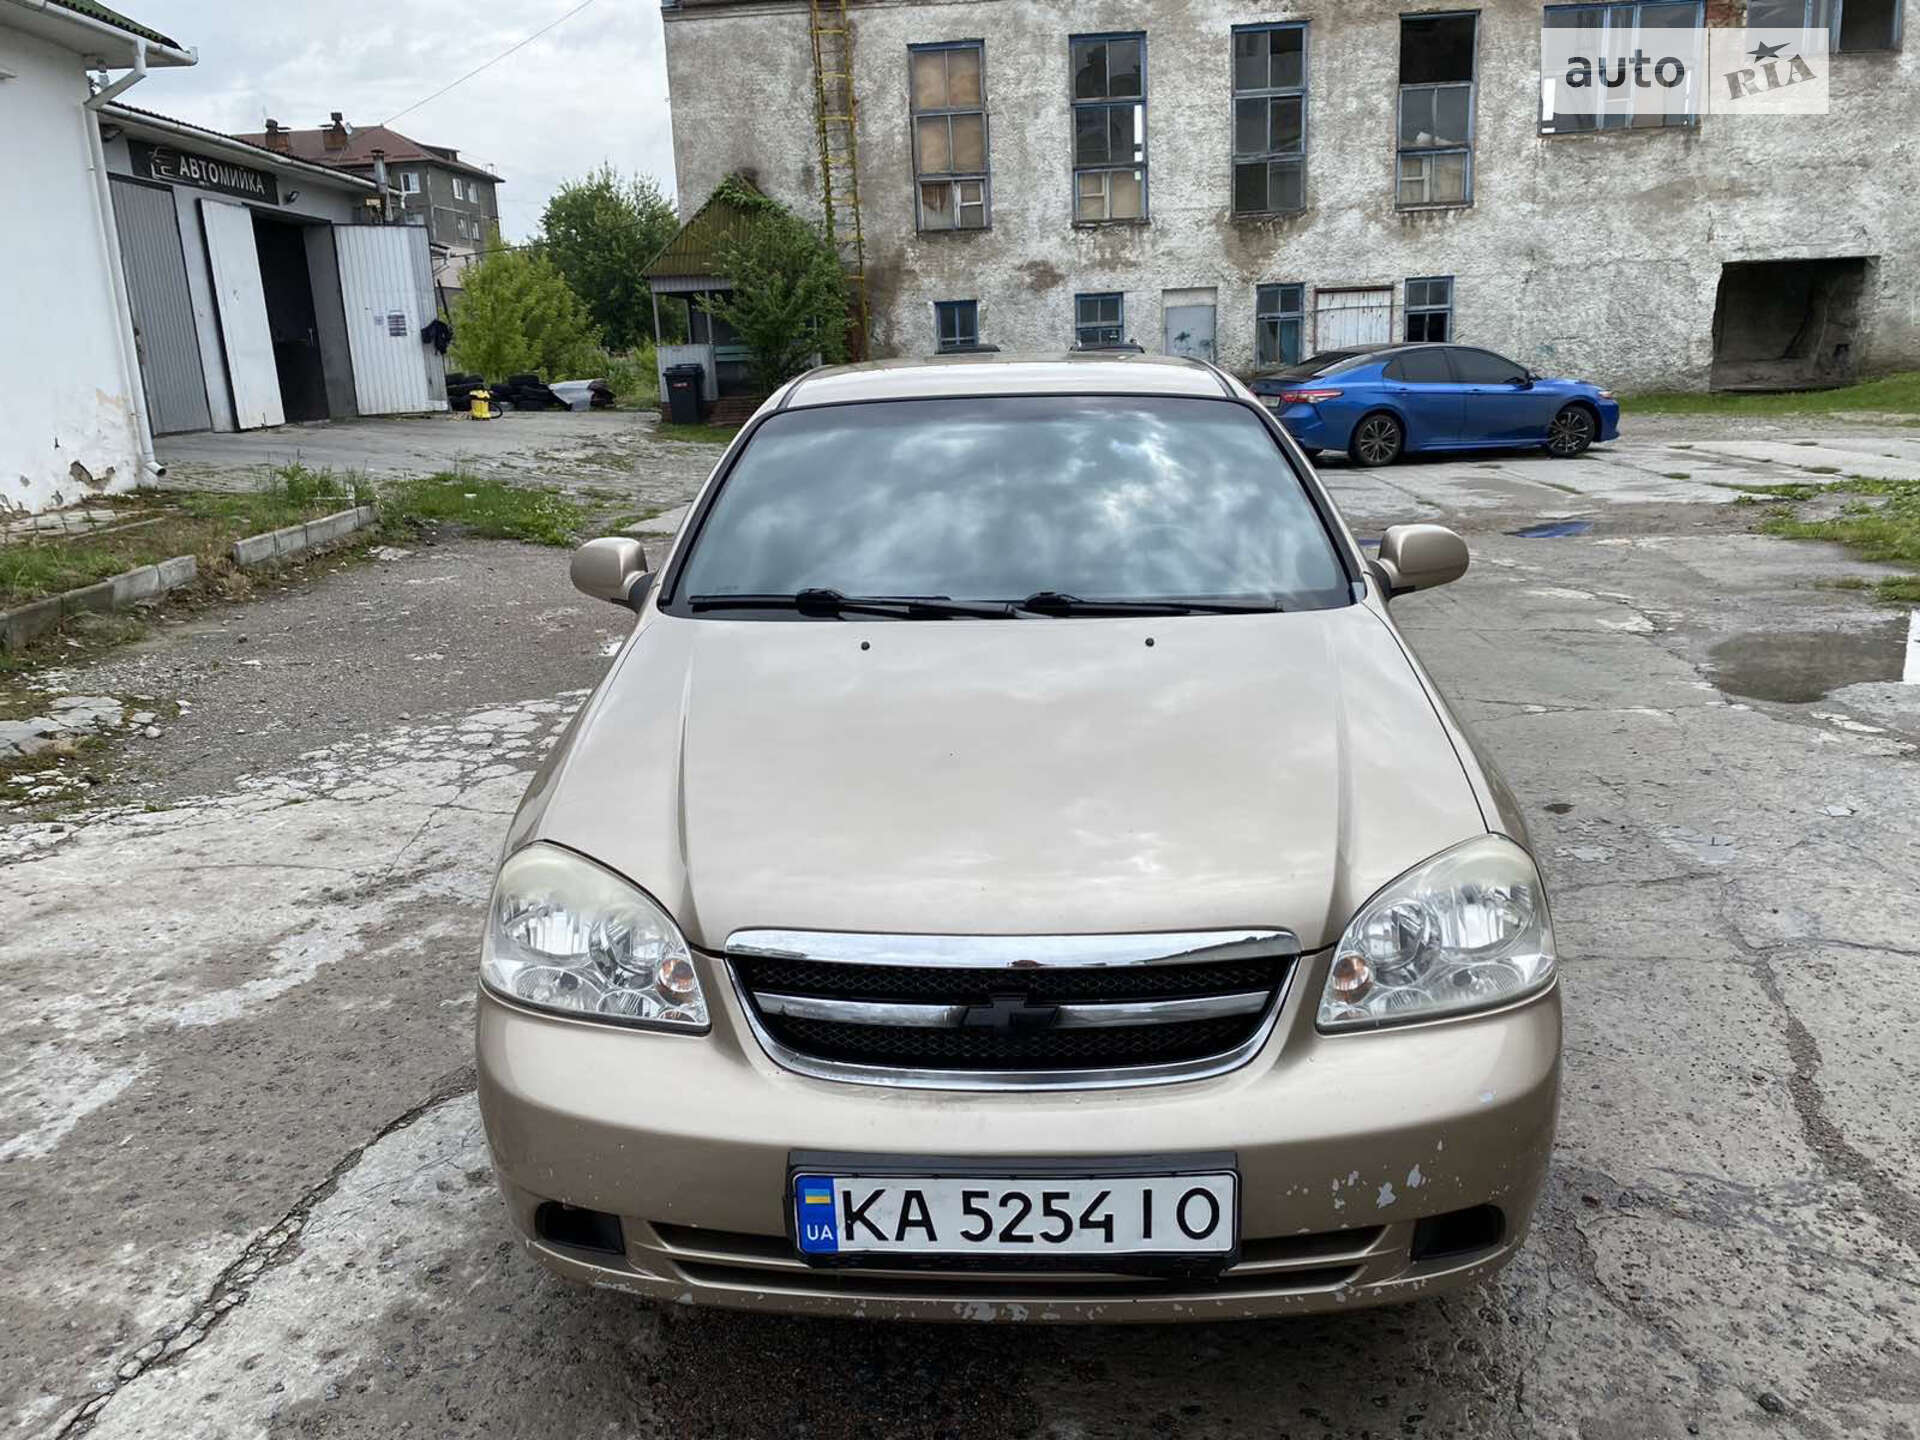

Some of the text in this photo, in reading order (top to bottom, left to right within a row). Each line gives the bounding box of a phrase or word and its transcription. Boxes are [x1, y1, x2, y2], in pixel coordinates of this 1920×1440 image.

[179, 155, 265, 194] АВТОМИЙКА
[806, 1223, 834, 1241] UA
[842, 1188, 938, 1242] KA
[959, 1190, 1113, 1243] 5254
